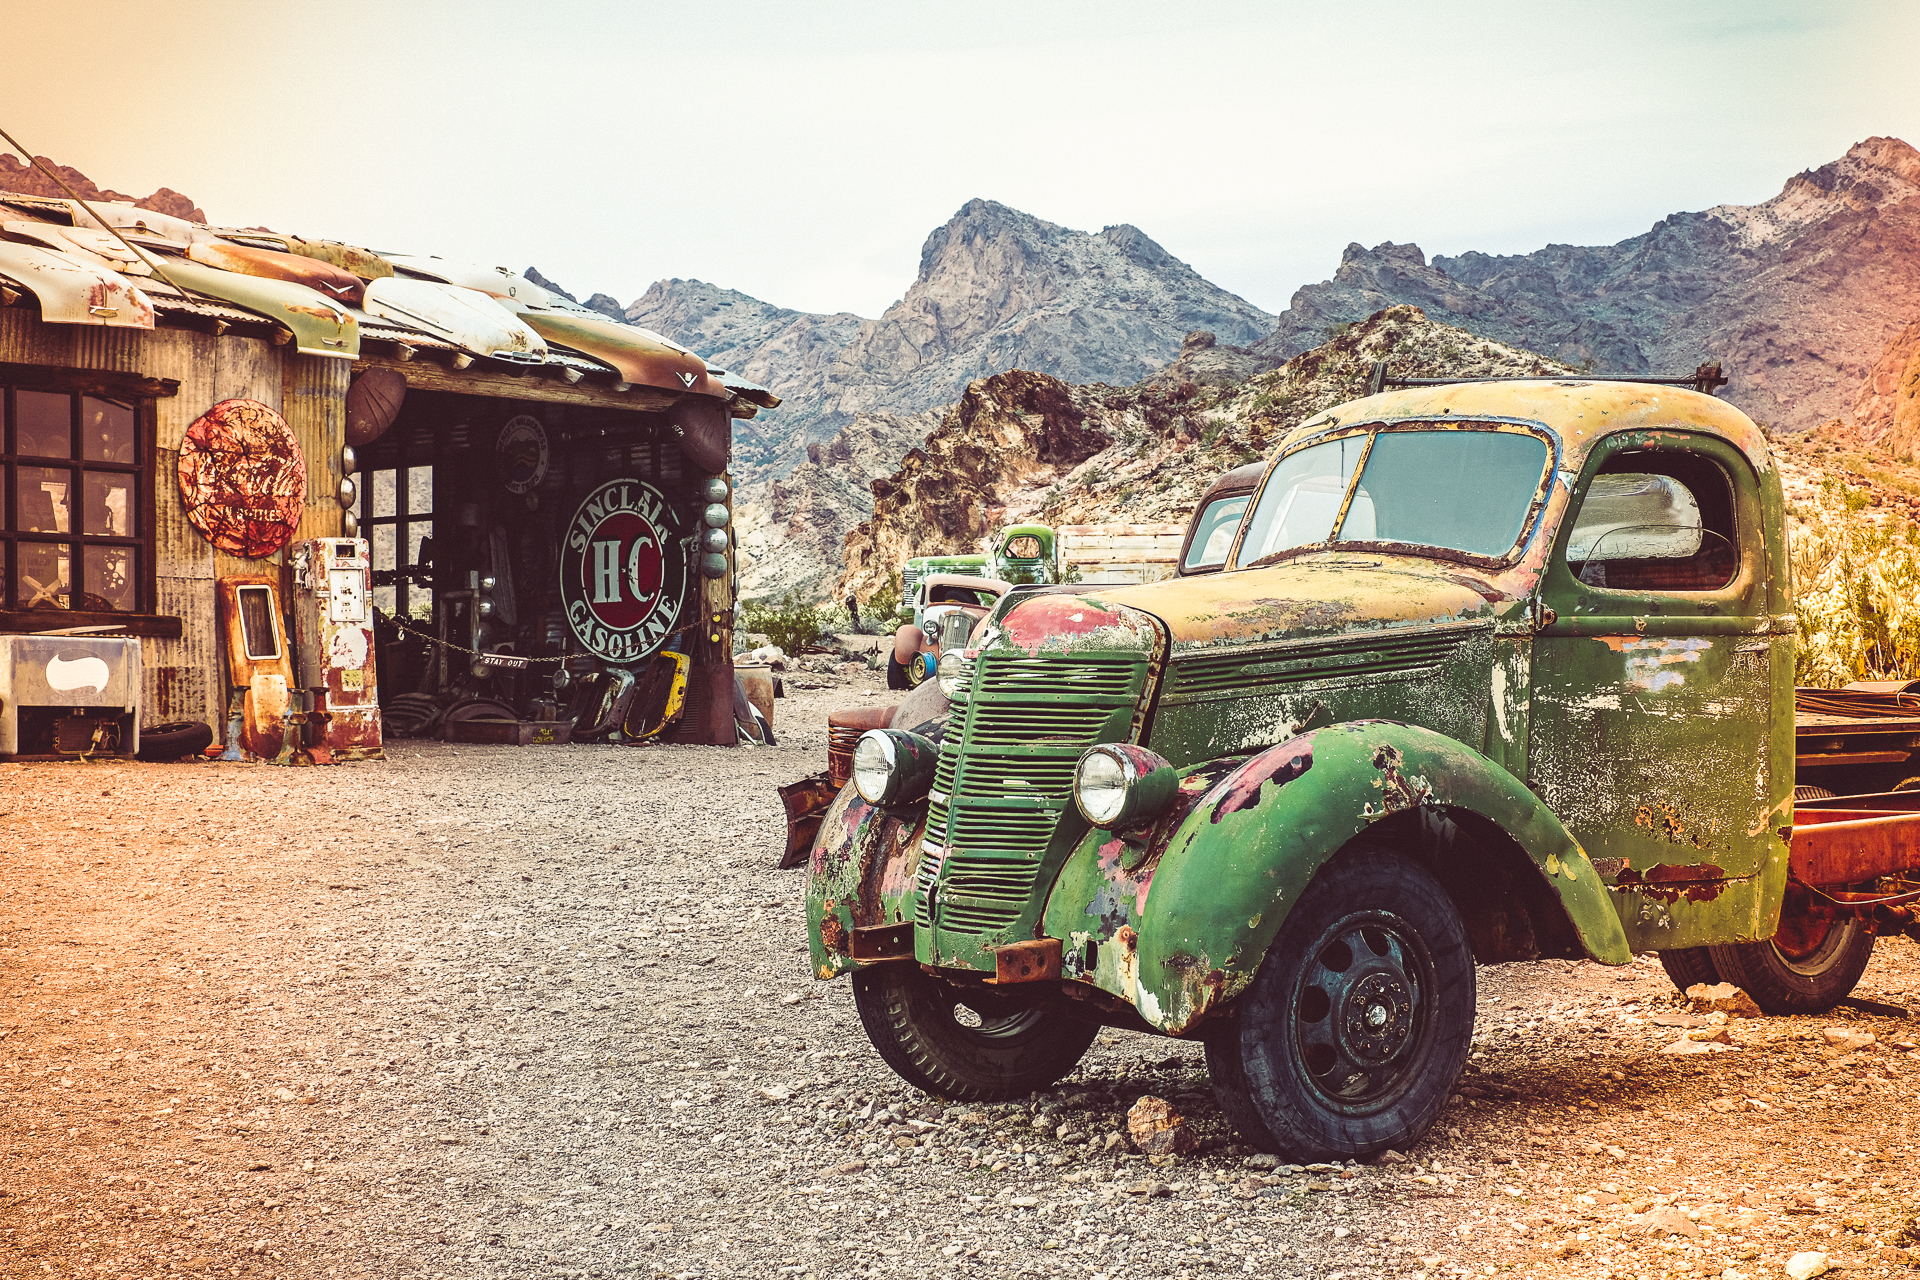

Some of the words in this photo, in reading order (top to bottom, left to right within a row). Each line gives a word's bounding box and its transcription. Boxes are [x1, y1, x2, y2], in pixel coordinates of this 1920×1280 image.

[570, 595, 678, 658] GASOLINE
[484, 657, 504, 666] STAY
[507, 659, 524, 668] OUT
